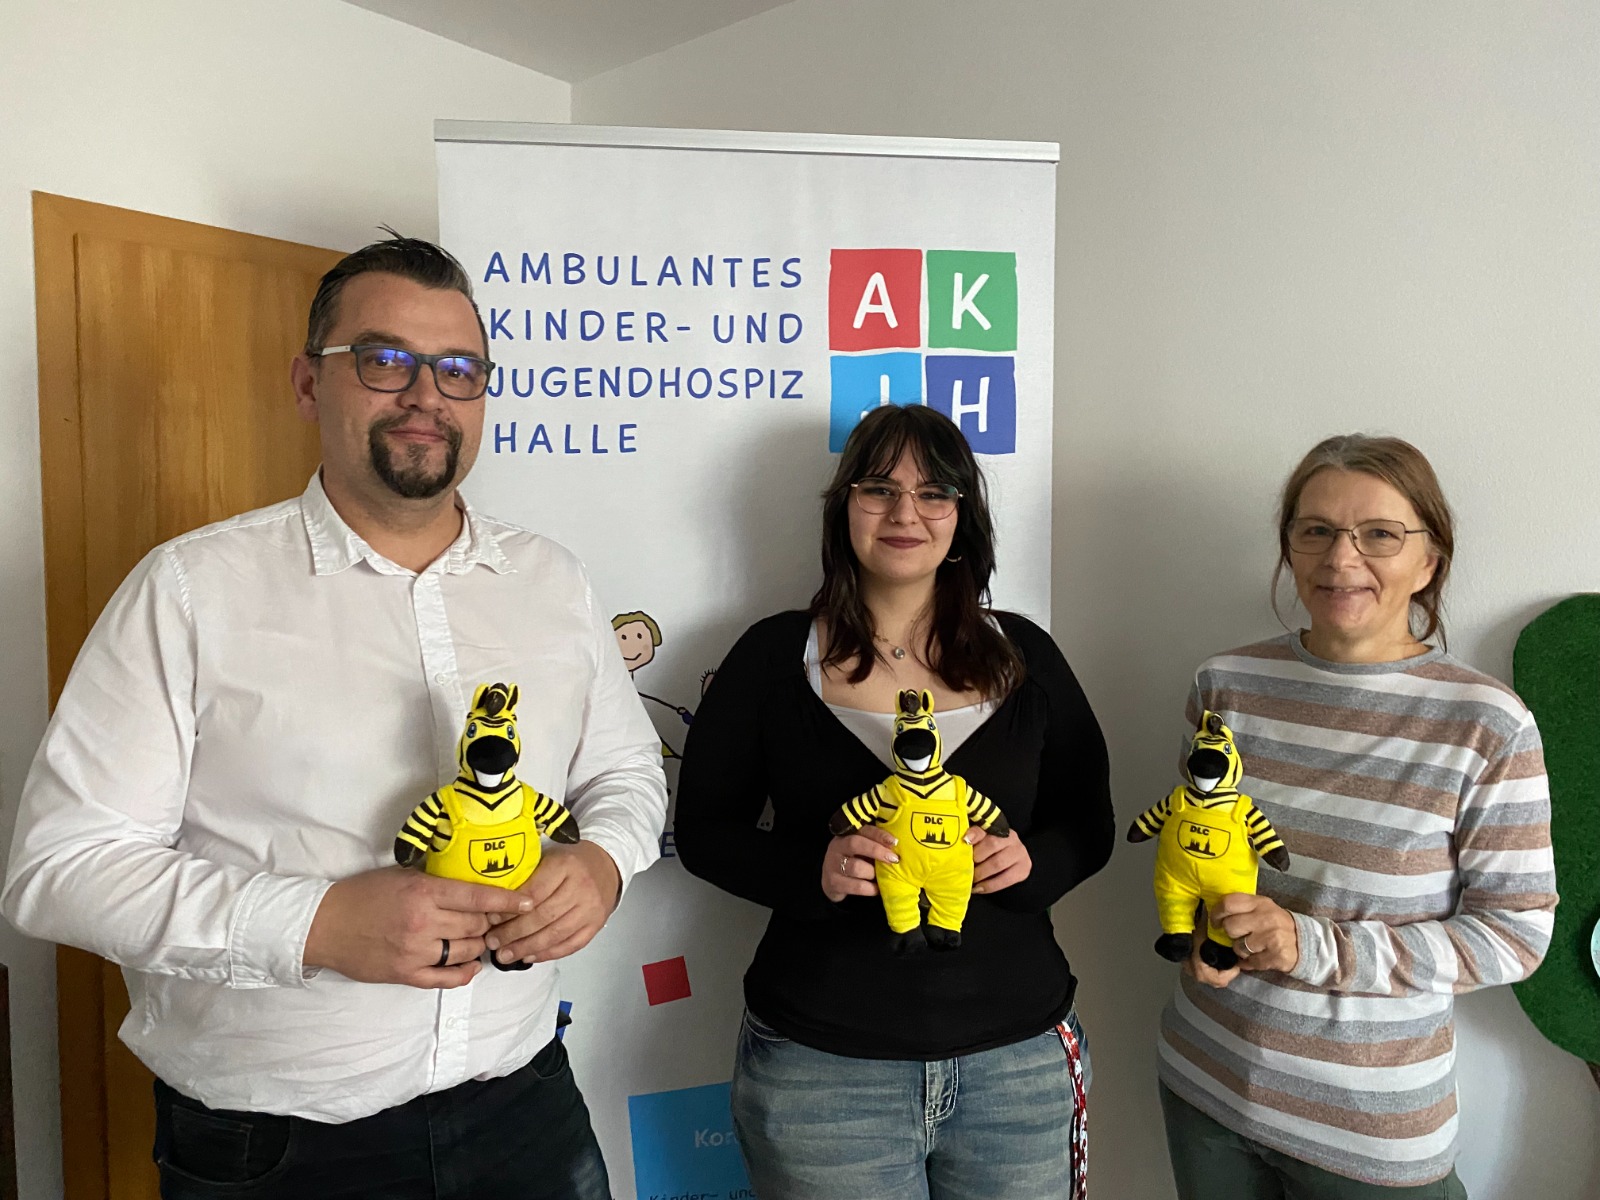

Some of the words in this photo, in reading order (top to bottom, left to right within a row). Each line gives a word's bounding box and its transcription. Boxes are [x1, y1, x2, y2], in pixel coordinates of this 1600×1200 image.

[483, 251, 802, 289] AMBULANTES
[852, 272, 899, 329] A
[952, 272, 992, 331] K
[490, 308, 690, 344] KINDER-
[713, 312, 803, 344] UND
[487, 366, 804, 399] JUGENDHOSPIZ
[494, 421, 637, 454] HALLE
[924, 816, 943, 825] DLC
[1190, 825, 1210, 836] DLC
[484, 840, 506, 852] DLC
